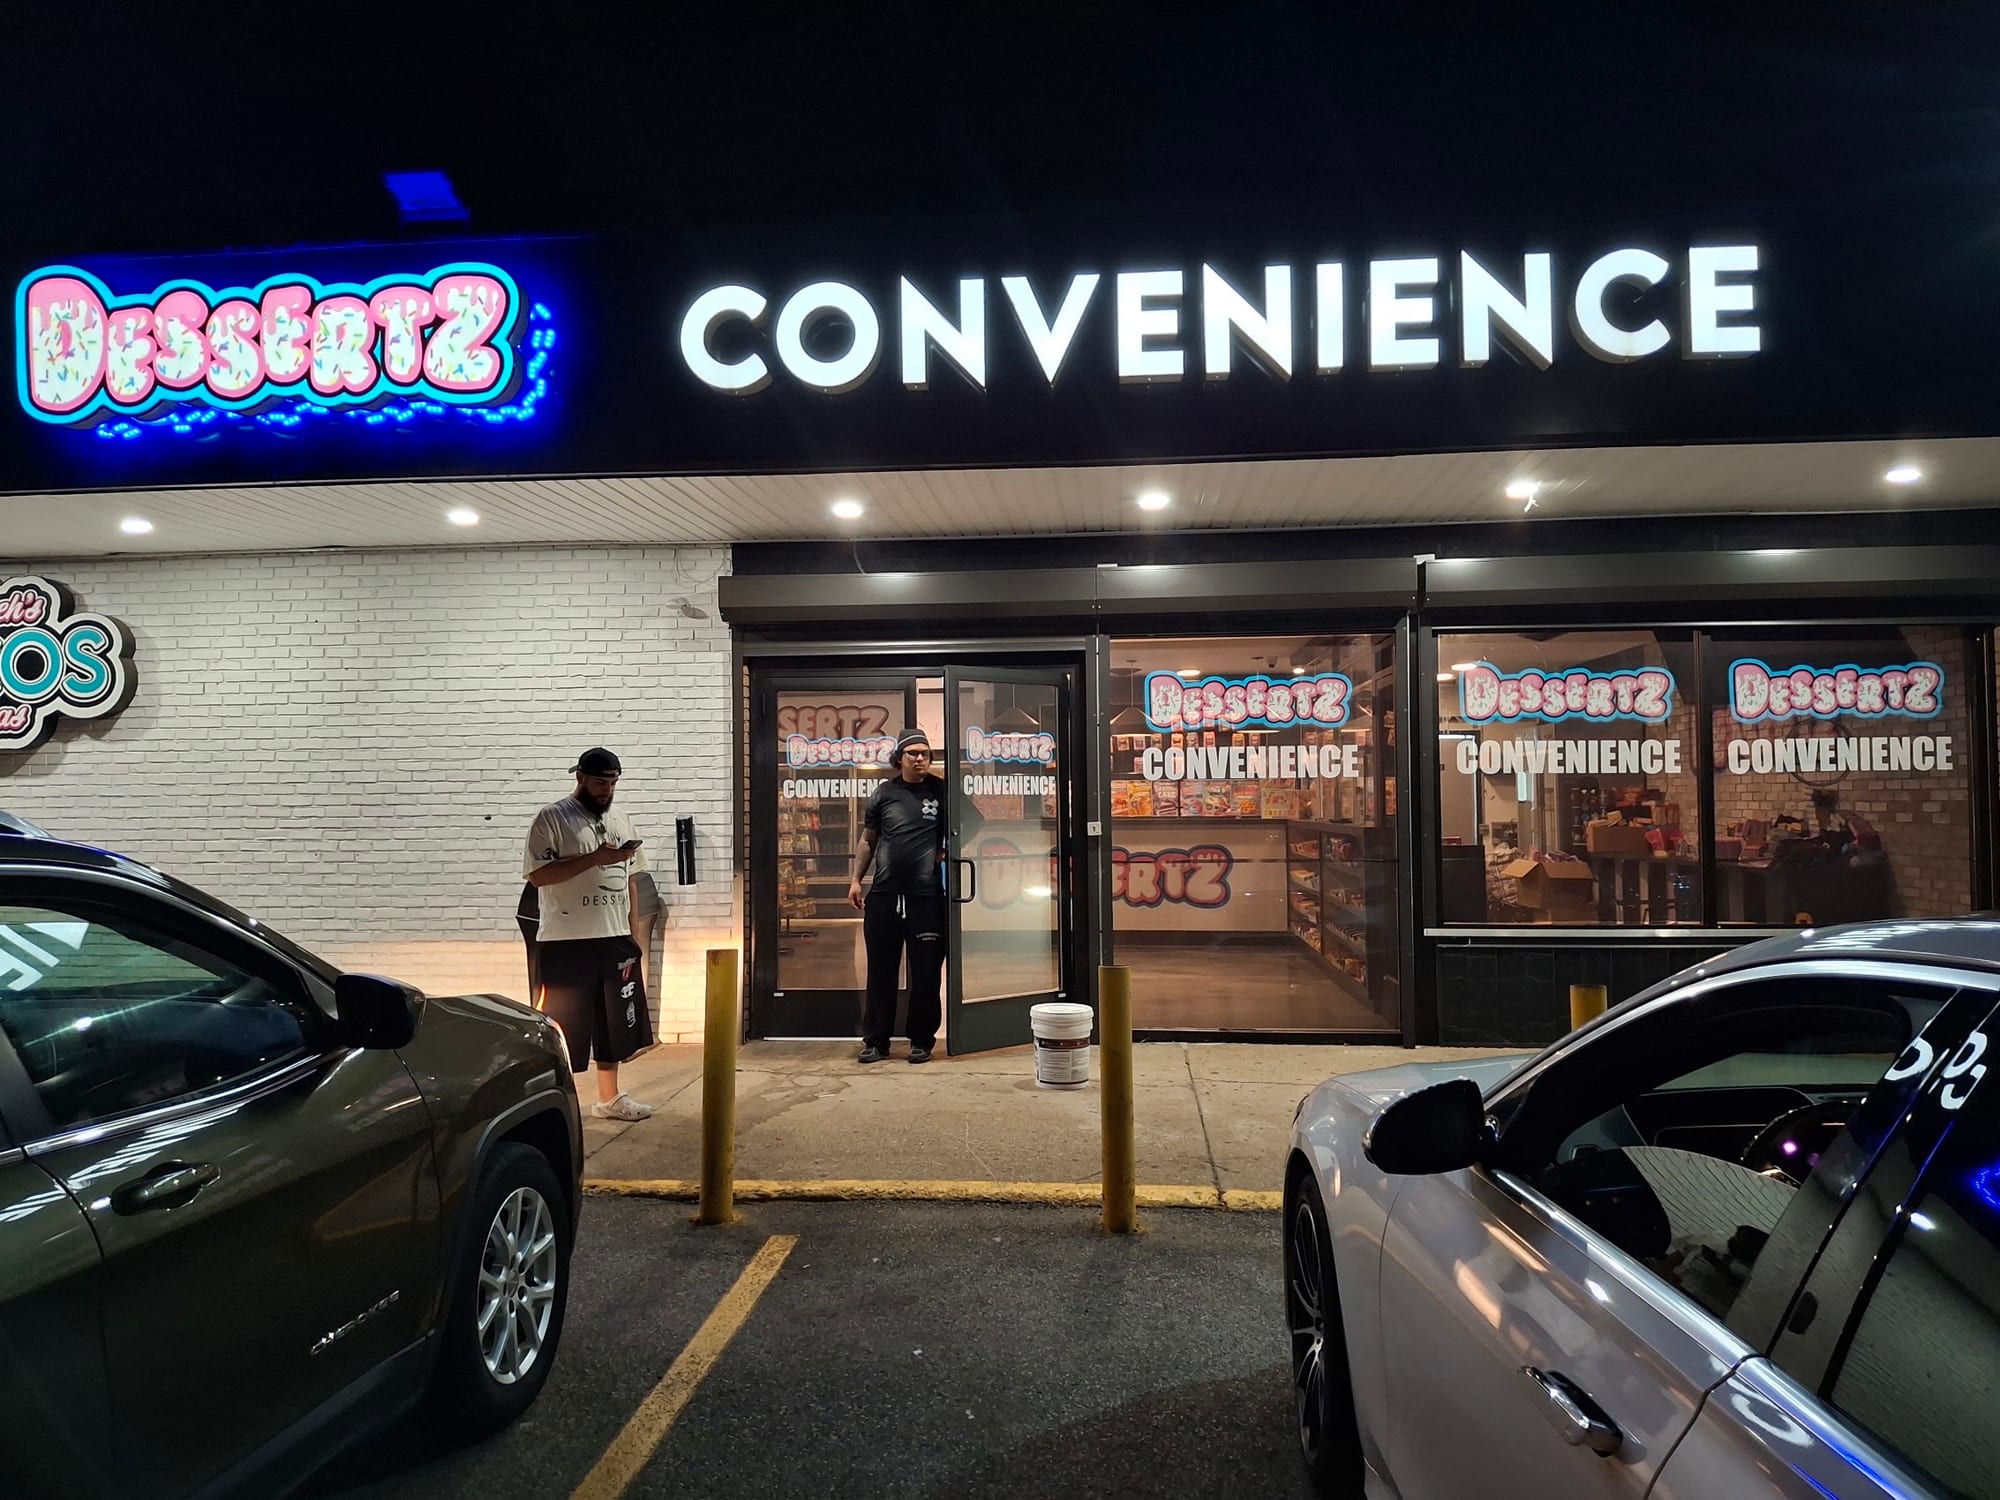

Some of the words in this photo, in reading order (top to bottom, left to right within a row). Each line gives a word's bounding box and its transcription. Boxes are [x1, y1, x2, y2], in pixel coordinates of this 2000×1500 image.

[680, 245, 1763, 392] CONVENIENCE
[25, 271, 512, 414] DESSERTZ
[1142, 744, 1358, 781] CONVENIENCE
[1456, 739, 1681, 775] CONVENIENCE
[1728, 735, 1953, 775] CONVENIENCE
[783, 778, 889, 799] CONVENIEN
[963, 774, 1055, 796] CONVENIENCE
